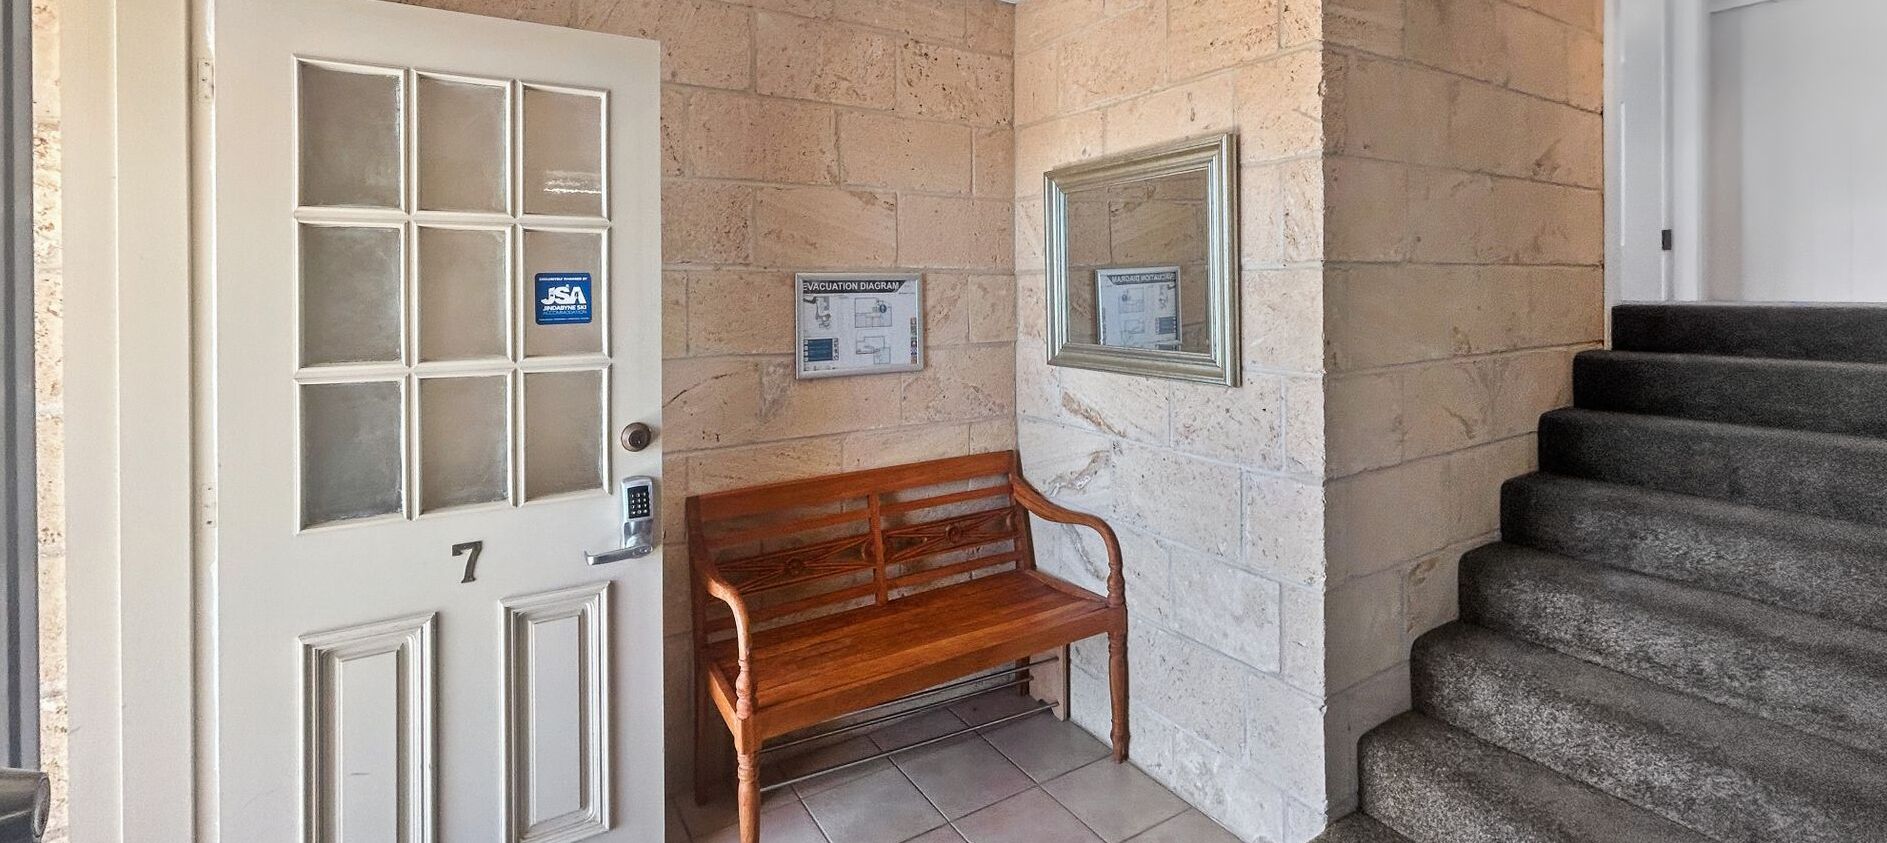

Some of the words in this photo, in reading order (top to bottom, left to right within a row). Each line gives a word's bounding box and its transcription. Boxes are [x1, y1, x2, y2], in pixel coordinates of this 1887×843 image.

[541, 285, 587, 305] JSA
[803, 282, 858, 291] EVACUATION
[860, 281, 899, 290] DIAGRAM
[452, 540, 483, 583] 7
